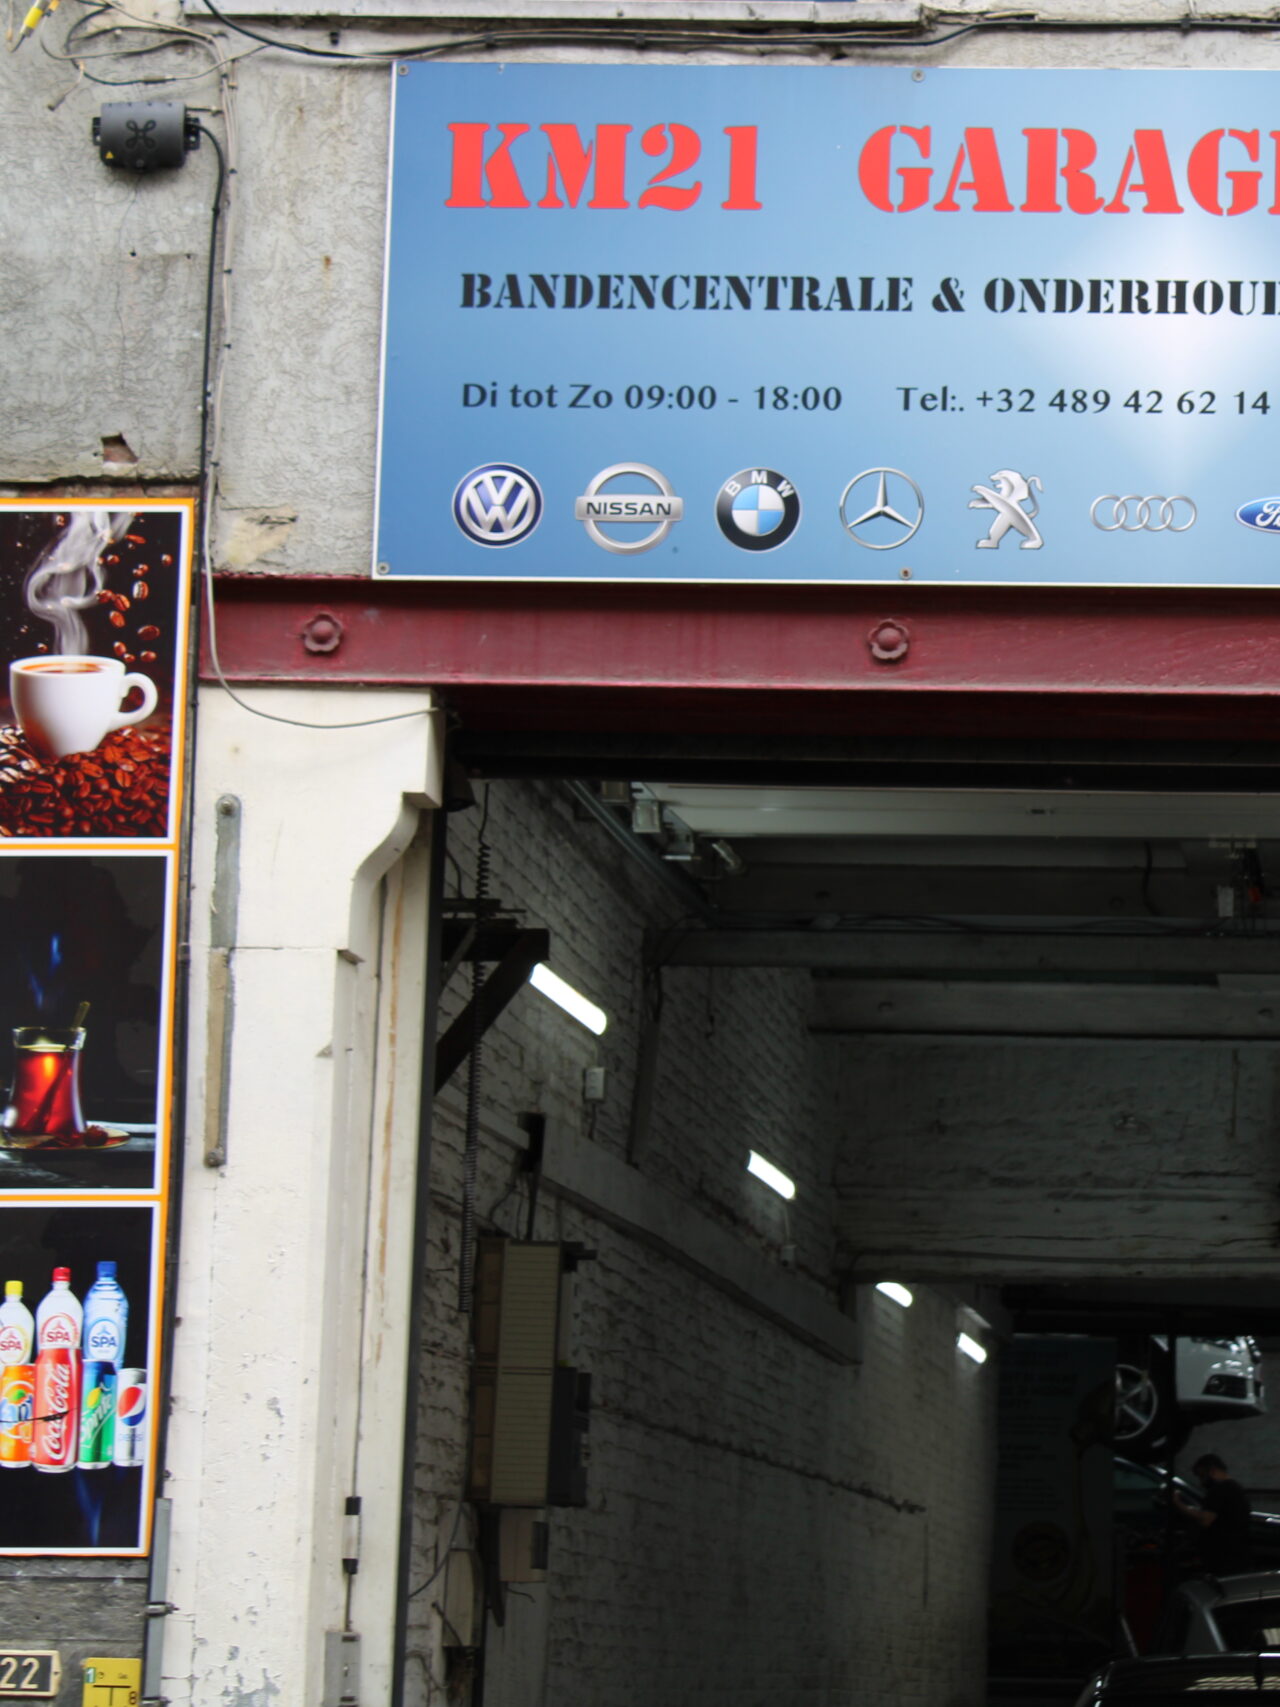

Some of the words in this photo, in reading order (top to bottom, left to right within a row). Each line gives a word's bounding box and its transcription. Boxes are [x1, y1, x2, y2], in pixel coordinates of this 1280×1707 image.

[445, 123, 762, 211] KM21
[460, 273, 913, 312] BANDENCENTRALE
[932, 277, 966, 313] &
[462, 382, 498, 409] Di
[510, 384, 558, 409] tot
[567, 384, 613, 409] Zo
[624, 385, 717, 410] 09:00
[753, 386, 843, 411] 18:00
[896, 386, 965, 412] Tel:.
[976, 388, 1035, 413] +32
[1048, 388, 1111, 414] 489
[1123, 389, 1163, 414] 42
[1176, 390, 1217, 414] 62
[1233, 390, 1271, 415] 14
[725, 470, 794, 499] BMW
[586, 501, 671, 516] NISSAN
[47, 1331, 71, 1342] SPA
[91, 1336, 117, 1348] SPA
[42, 1363, 70, 1460] CocaCola
[0, 1657, 39, 1689] 22
